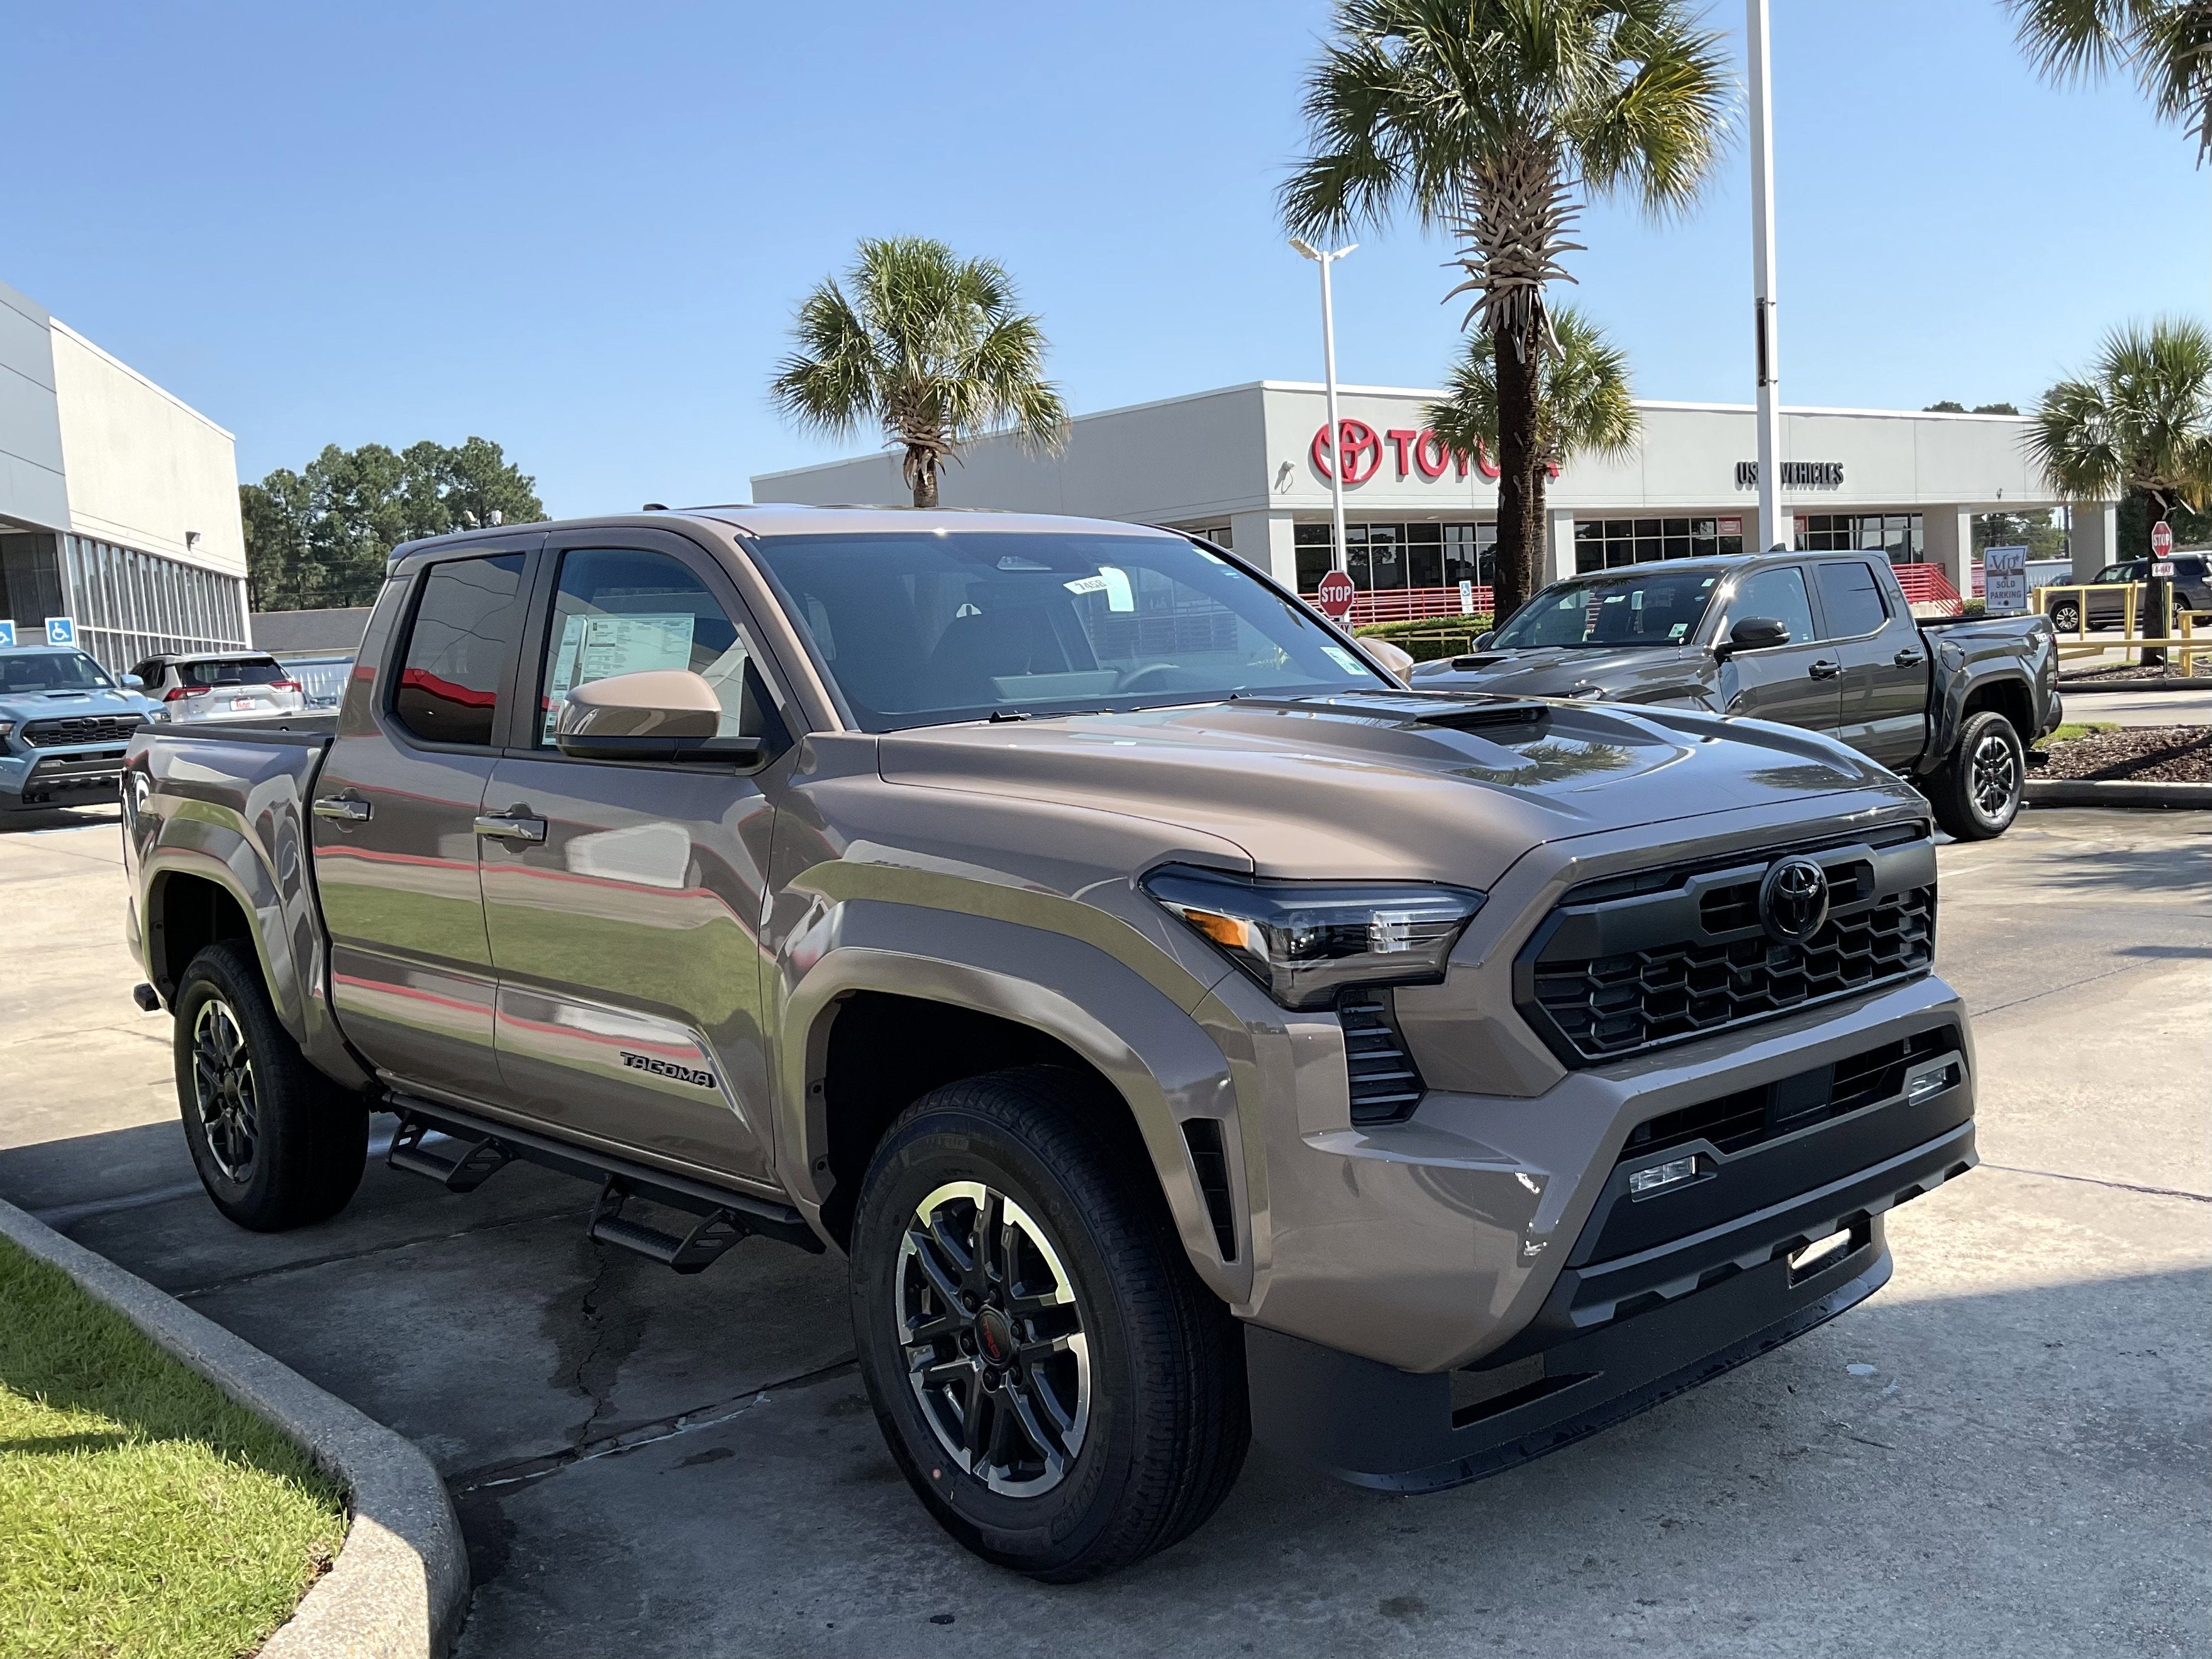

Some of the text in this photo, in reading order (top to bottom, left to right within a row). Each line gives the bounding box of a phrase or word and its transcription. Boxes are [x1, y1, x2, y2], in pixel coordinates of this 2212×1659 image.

[1780, 462, 1844, 484] VEHICLES
[2154, 533, 2170, 546] STOP
[2155, 565, 2171, 574] 4-WAY
[1321, 586, 1351, 602] STOP
[1990, 591, 2021, 599] PARKING
[620, 1051, 716, 1088] TACOMA
